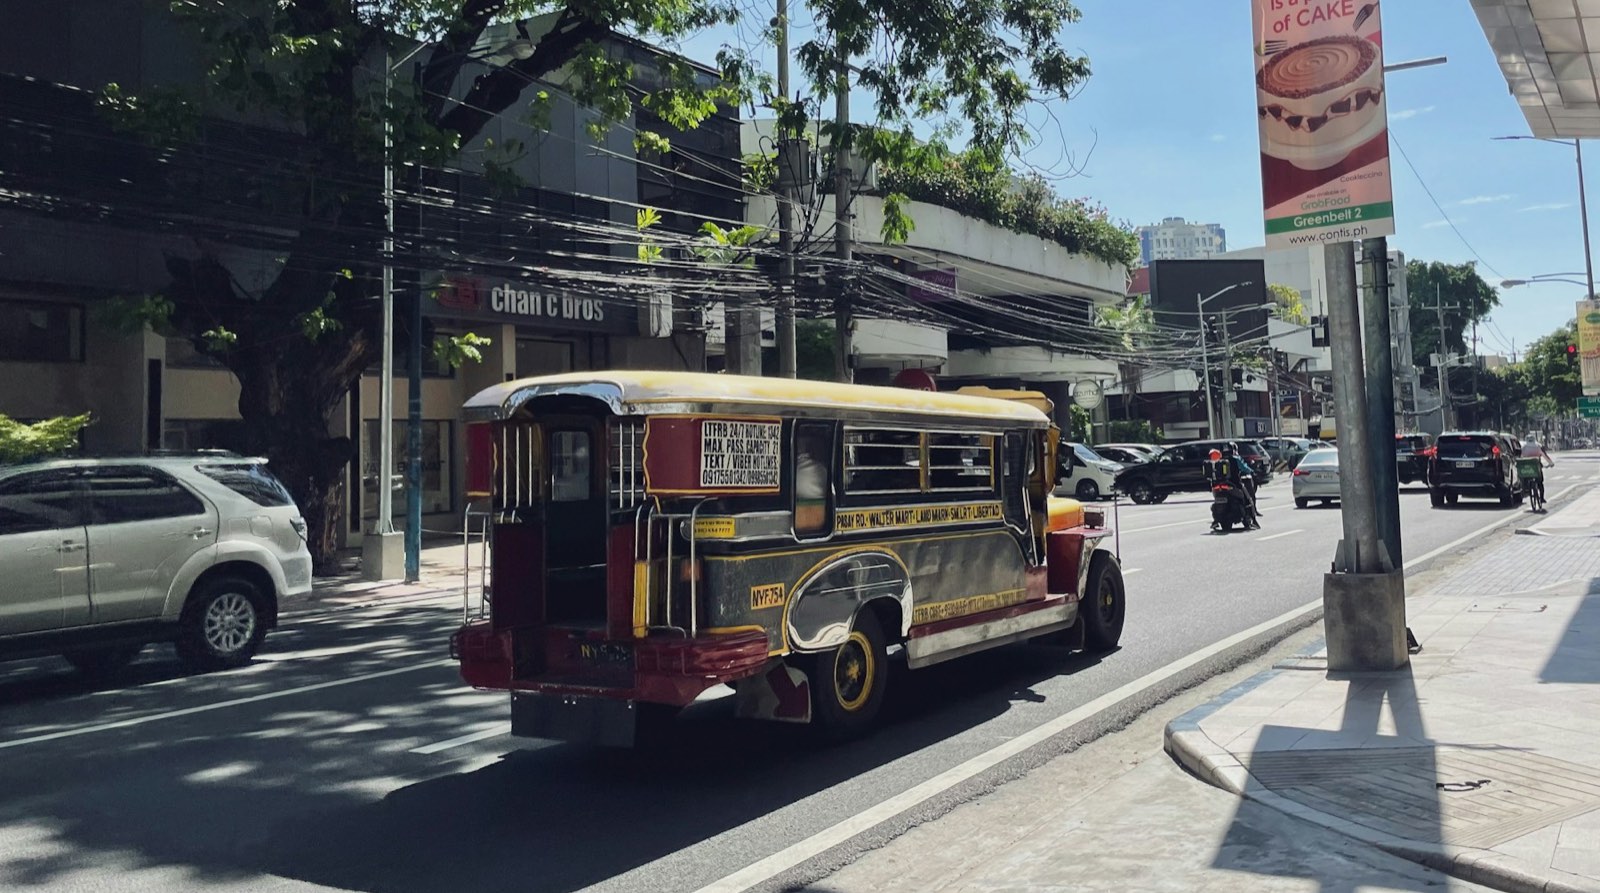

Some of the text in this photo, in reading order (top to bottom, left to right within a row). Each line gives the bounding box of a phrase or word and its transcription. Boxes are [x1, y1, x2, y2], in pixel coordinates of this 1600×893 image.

[1273, 0, 1354, 33] of CAKE
[1301, 195, 1351, 210] GrabFood
[1293, 207, 1362, 228] Greenbelt 2
[1289, 224, 1368, 245] www.contis.ph
[491, 283, 604, 322] chan c bros
[704, 422, 728, 438] LTFRB
[729, 423, 745, 439] 24/7
[704, 454, 725, 469] TEXT
[732, 454, 752, 470] VIBER
